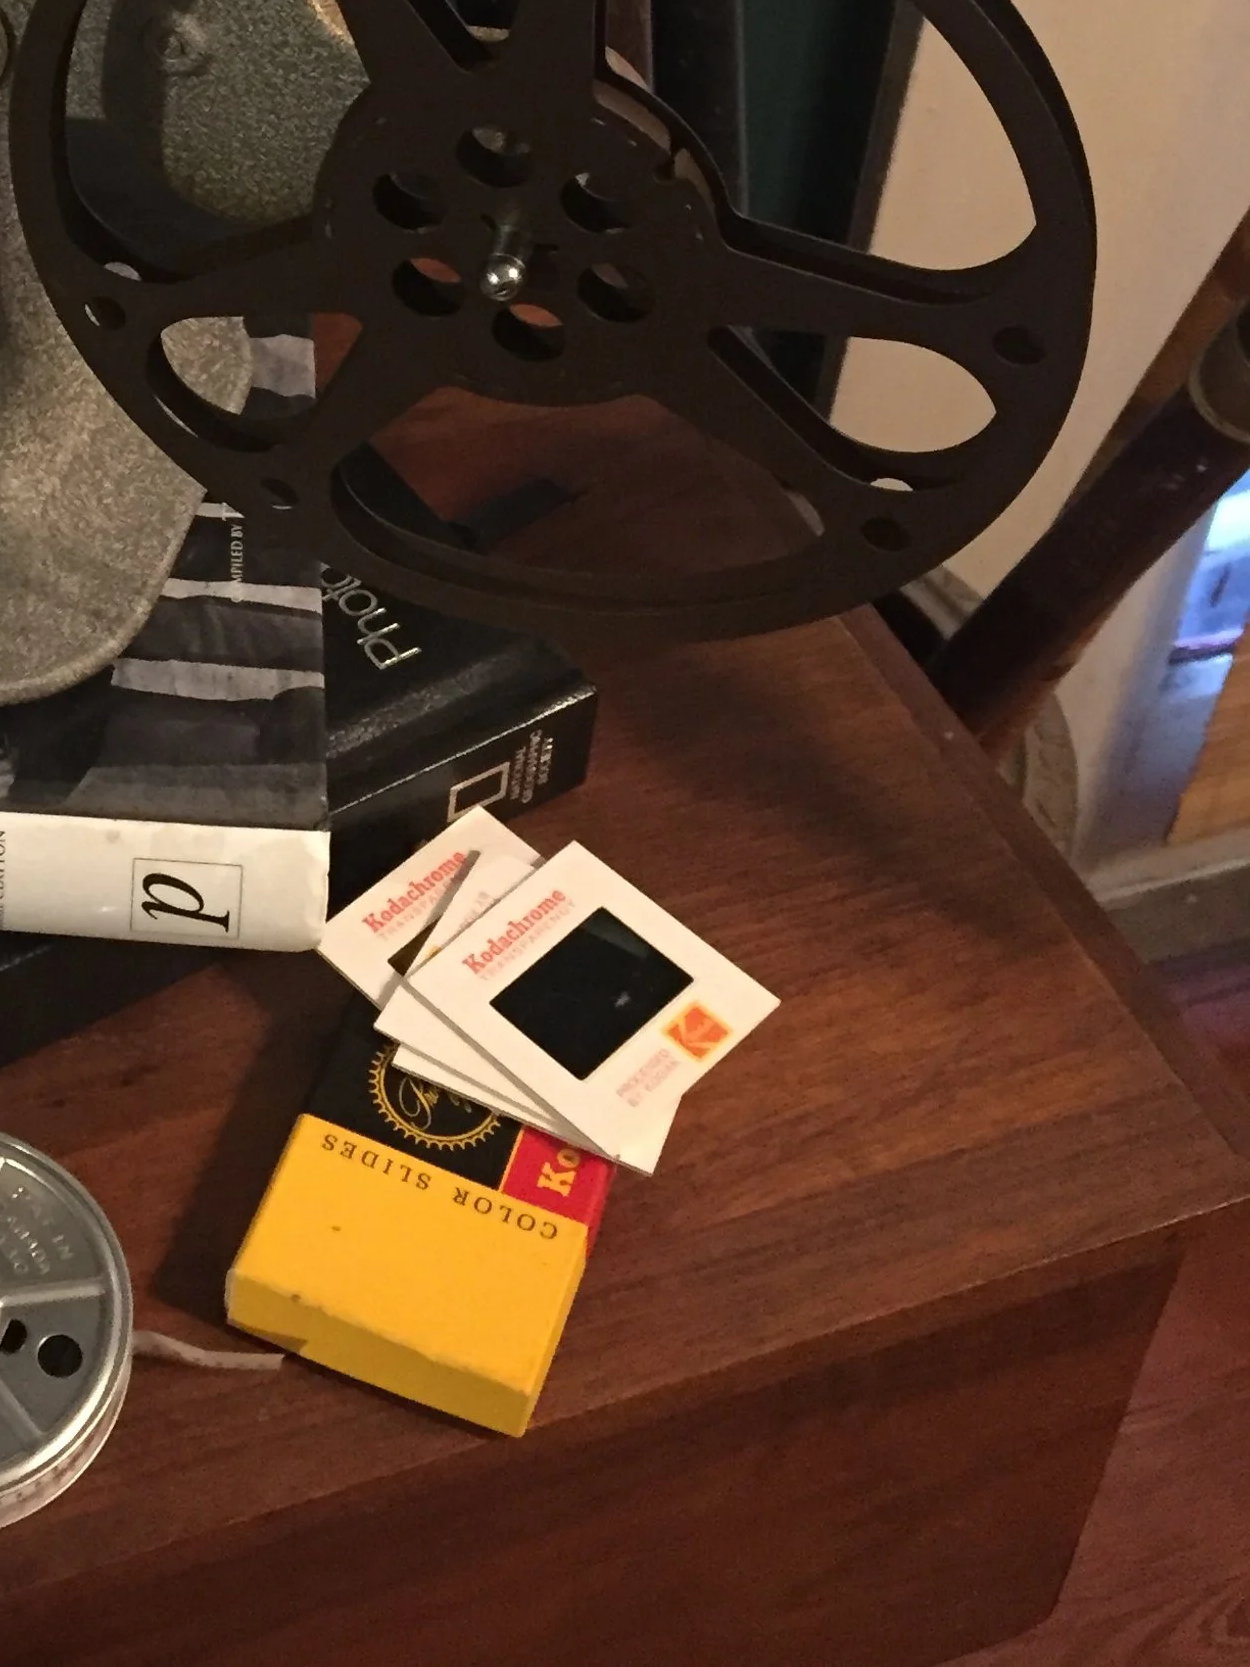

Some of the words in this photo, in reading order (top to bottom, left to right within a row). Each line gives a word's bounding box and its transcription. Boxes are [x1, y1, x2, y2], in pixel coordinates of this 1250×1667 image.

[362, 850, 467, 933] Kodachrome
[462, 888, 567, 975] Kodachrome
[321, 1133, 433, 1192] SLIDES
[452, 1186, 559, 1241] COLOR
